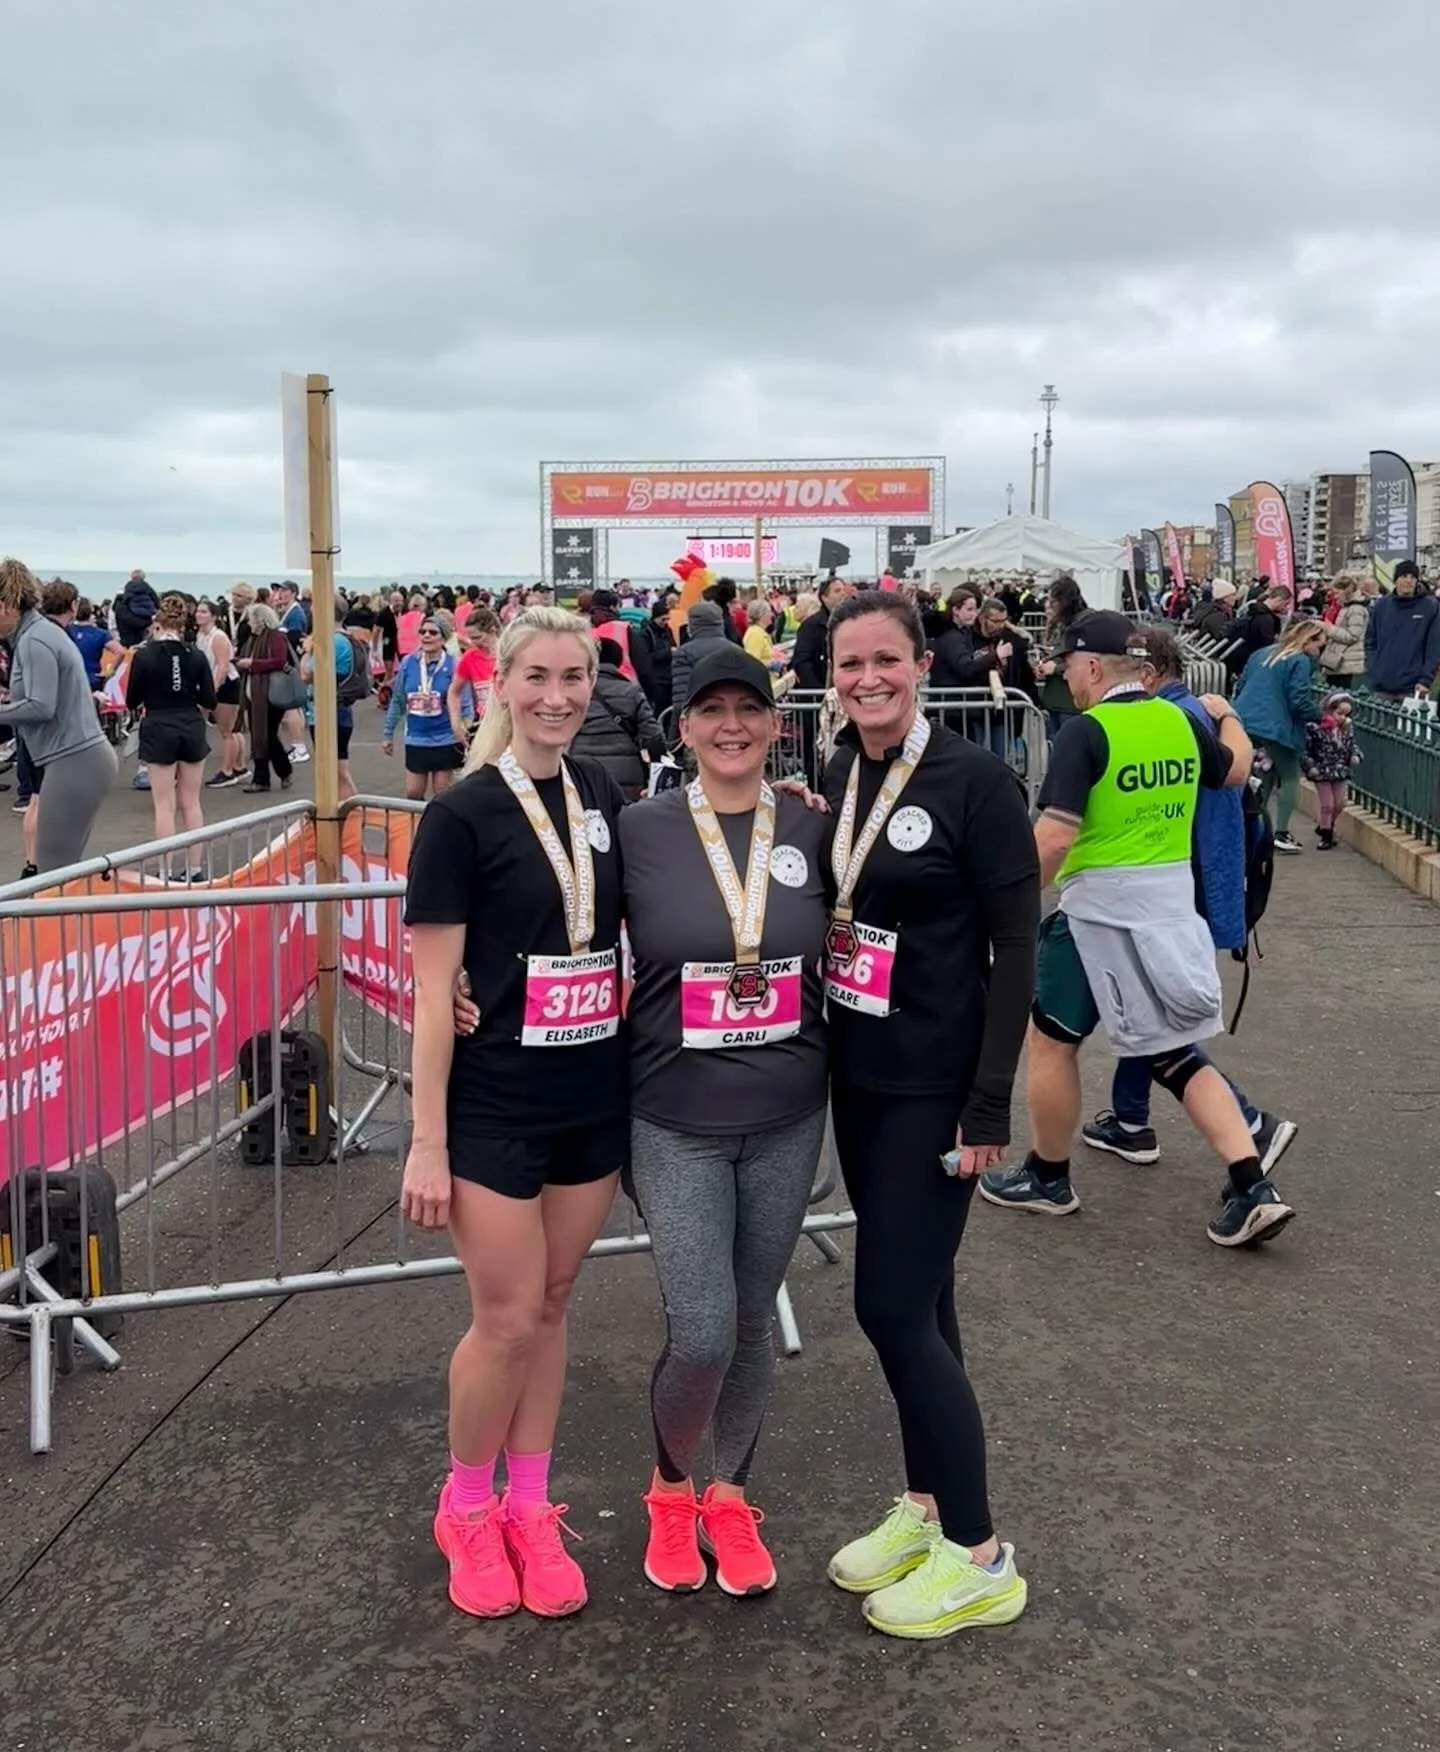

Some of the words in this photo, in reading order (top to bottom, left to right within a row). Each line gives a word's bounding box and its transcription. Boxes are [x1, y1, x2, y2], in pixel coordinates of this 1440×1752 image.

[711, 543, 751, 558] 1:19:00
[1116, 757, 1196, 793] GUIDE
[543, 978, 612, 1018] 3126
[829, 985, 860, 1006] CLARE
[544, 1023, 608, 1042] ELISABETH
[722, 1031, 767, 1044] CARLI
